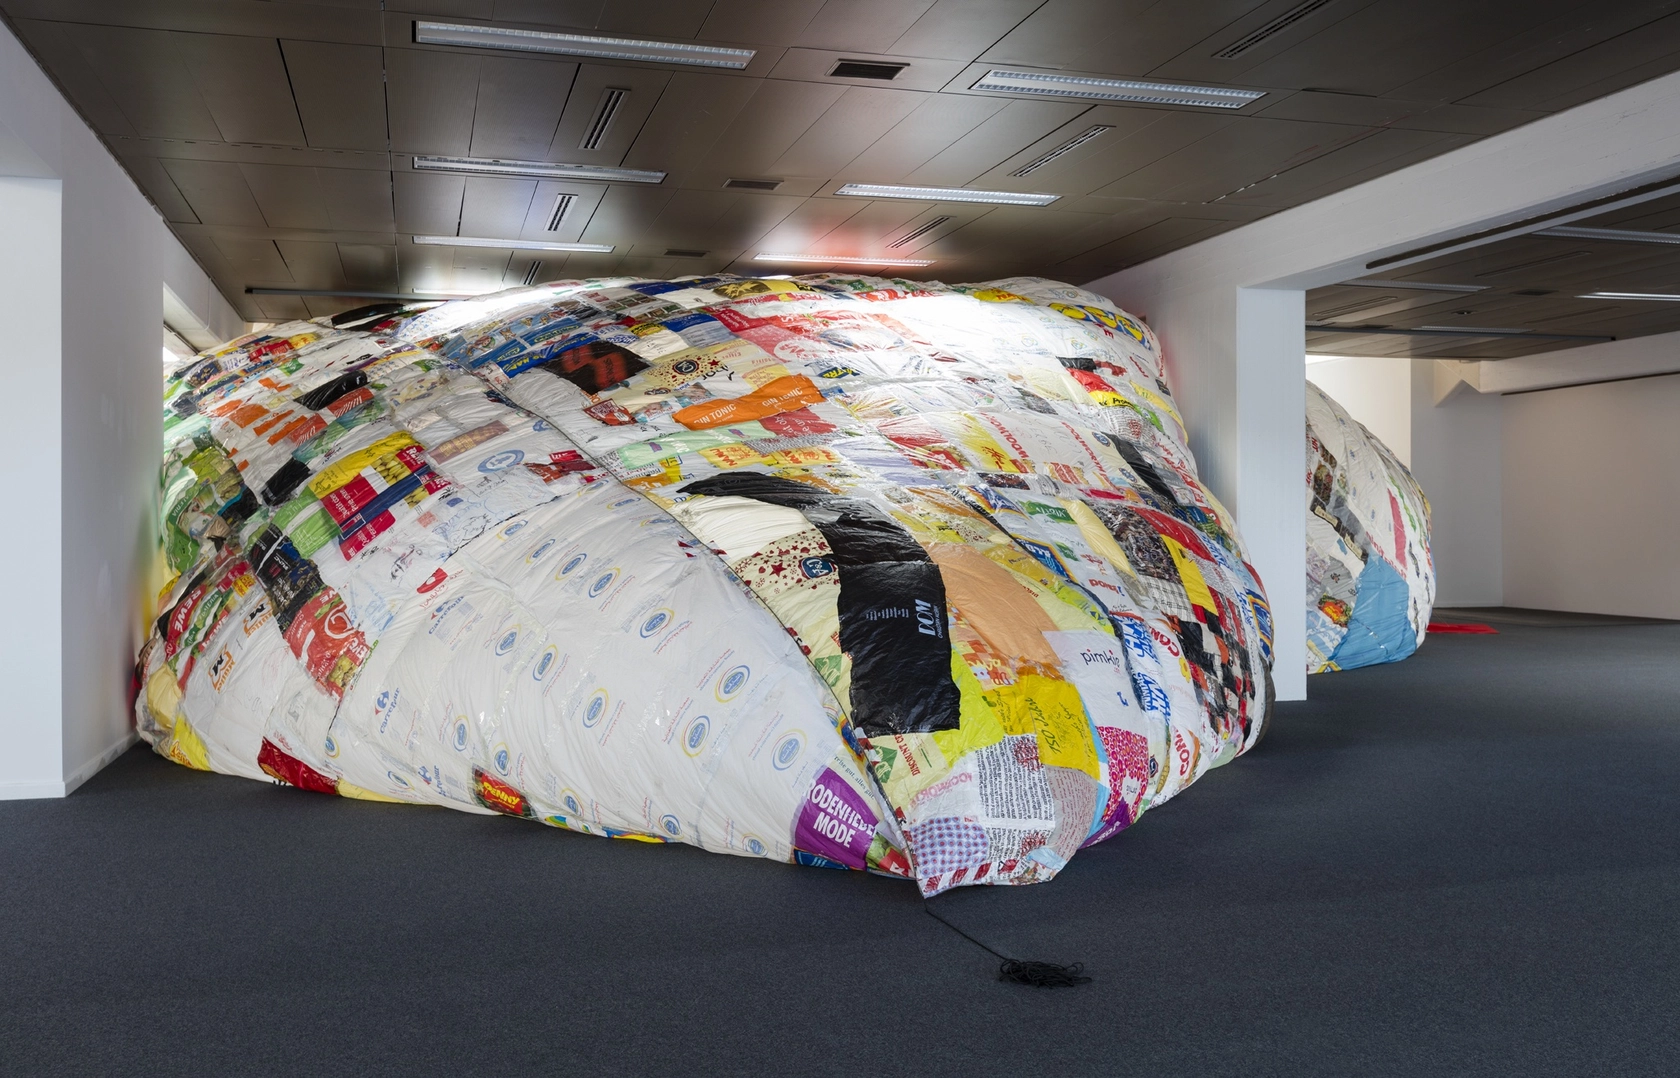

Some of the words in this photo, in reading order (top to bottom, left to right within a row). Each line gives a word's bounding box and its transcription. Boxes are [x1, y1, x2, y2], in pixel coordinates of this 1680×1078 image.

[709, 403, 737, 421] TONIC
[762, 396, 779, 408] GIN
[805, 557, 829, 579] C&A
[1088, 578, 1125, 597] pong!
[173, 588, 202, 632] REWE
[915, 599, 936, 637] DCM
[1080, 649, 1121, 668] pimkie
[380, 688, 401, 735] Carrefour
[894, 732, 904, 743] CE
[898, 742, 920, 776] DISCOUNT
[854, 775, 868, 789] alles
[483, 781, 521, 806] PENNY
[813, 811, 857, 848] MODE
